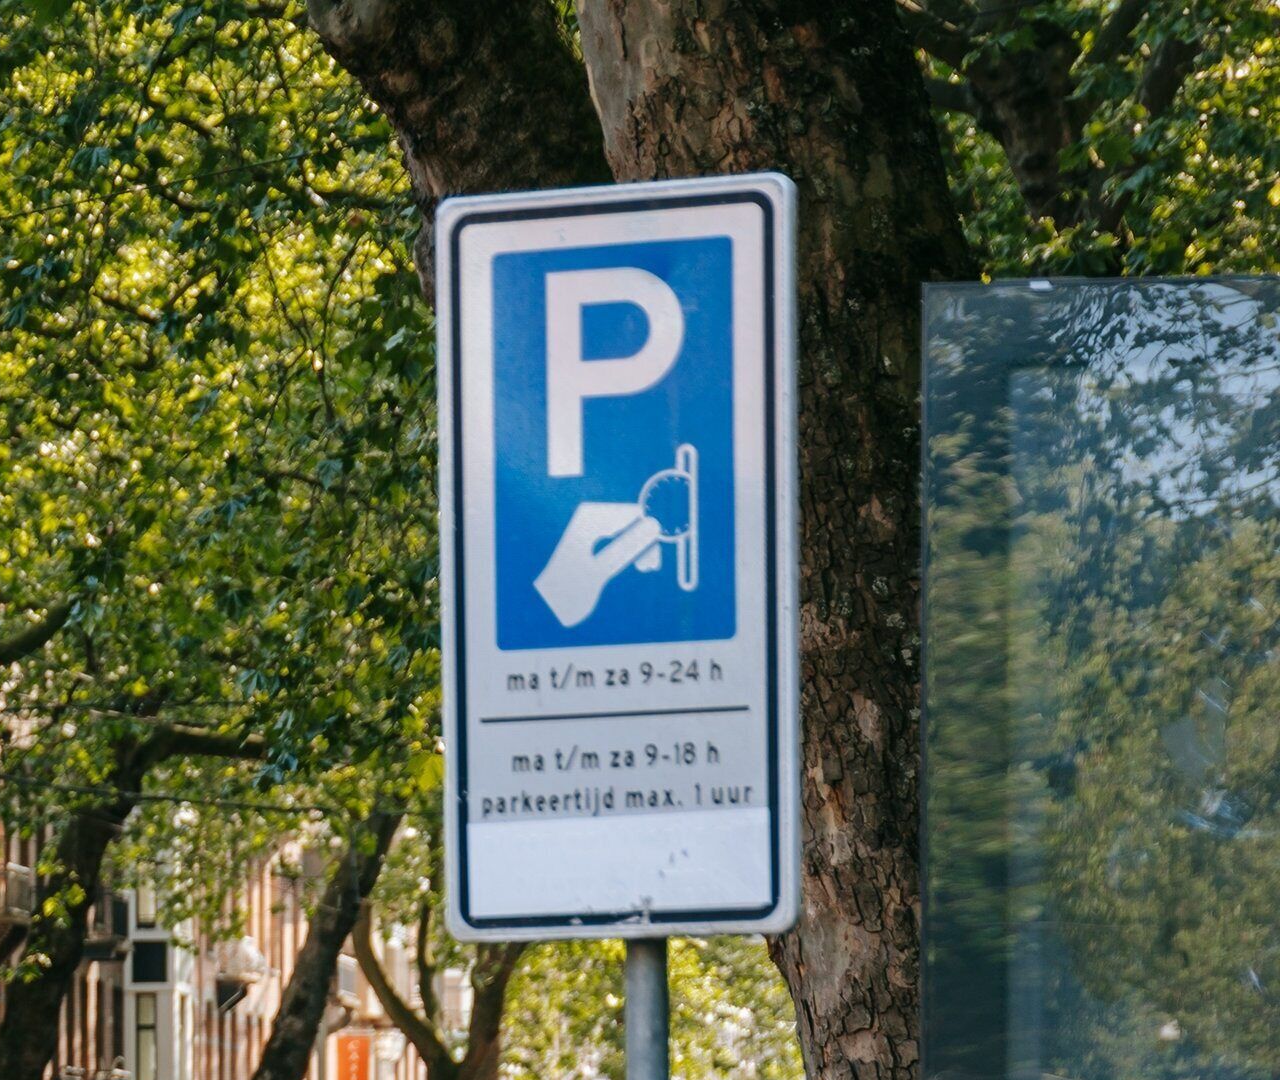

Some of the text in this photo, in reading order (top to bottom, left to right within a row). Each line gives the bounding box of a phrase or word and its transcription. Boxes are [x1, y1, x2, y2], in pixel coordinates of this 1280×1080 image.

[546, 266, 685, 478] P
[507, 659, 724, 691] ma t/m za 9-24 h
[512, 741, 721, 772] ma t/m za 9-18 h
[481, 786, 615, 818] parkeertijd
[625, 788, 683, 809] max.
[711, 784, 754, 804] uur
